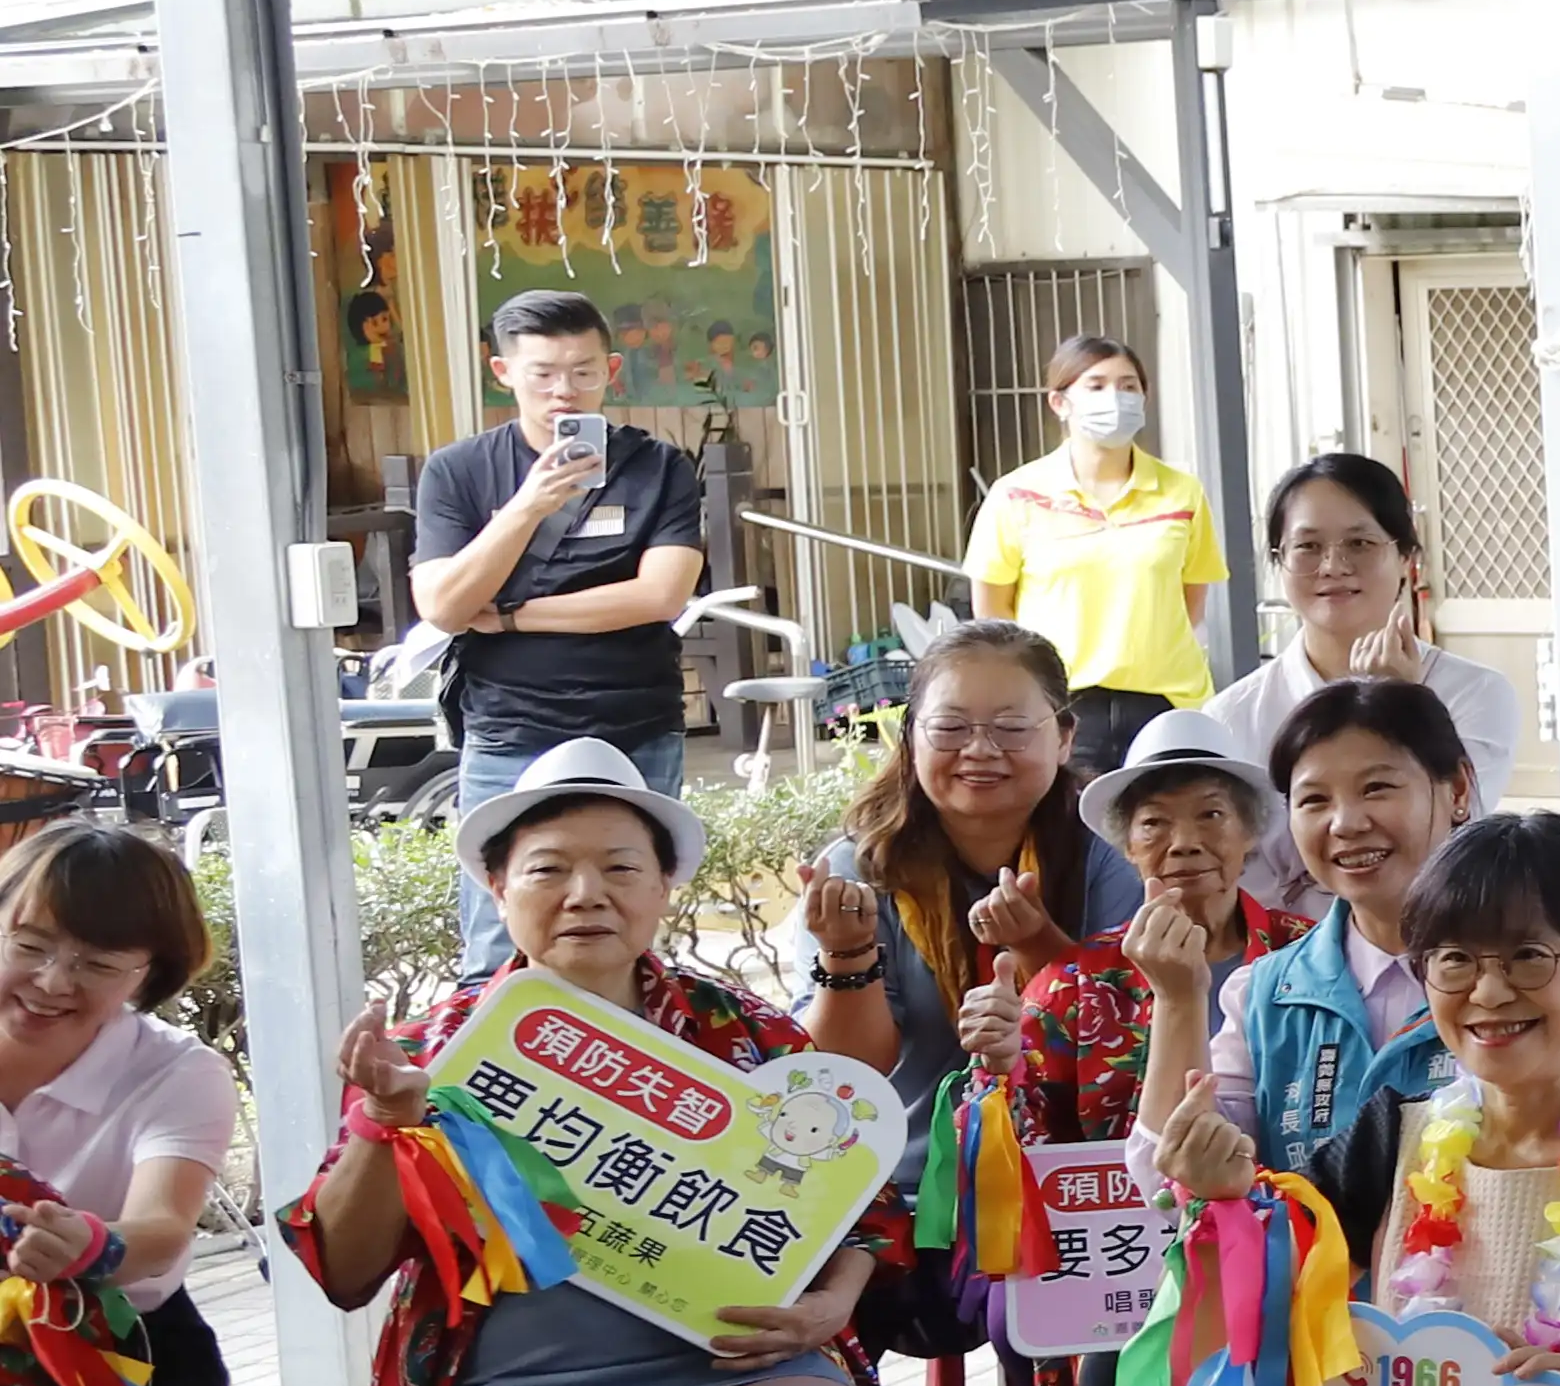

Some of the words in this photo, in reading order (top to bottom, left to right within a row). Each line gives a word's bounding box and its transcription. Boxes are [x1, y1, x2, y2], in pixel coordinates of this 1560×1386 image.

[523, 1014, 725, 1138] 預防失智
[1056, 1169, 1144, 1208] 預防
[1041, 1222, 1179, 1284] 要多
